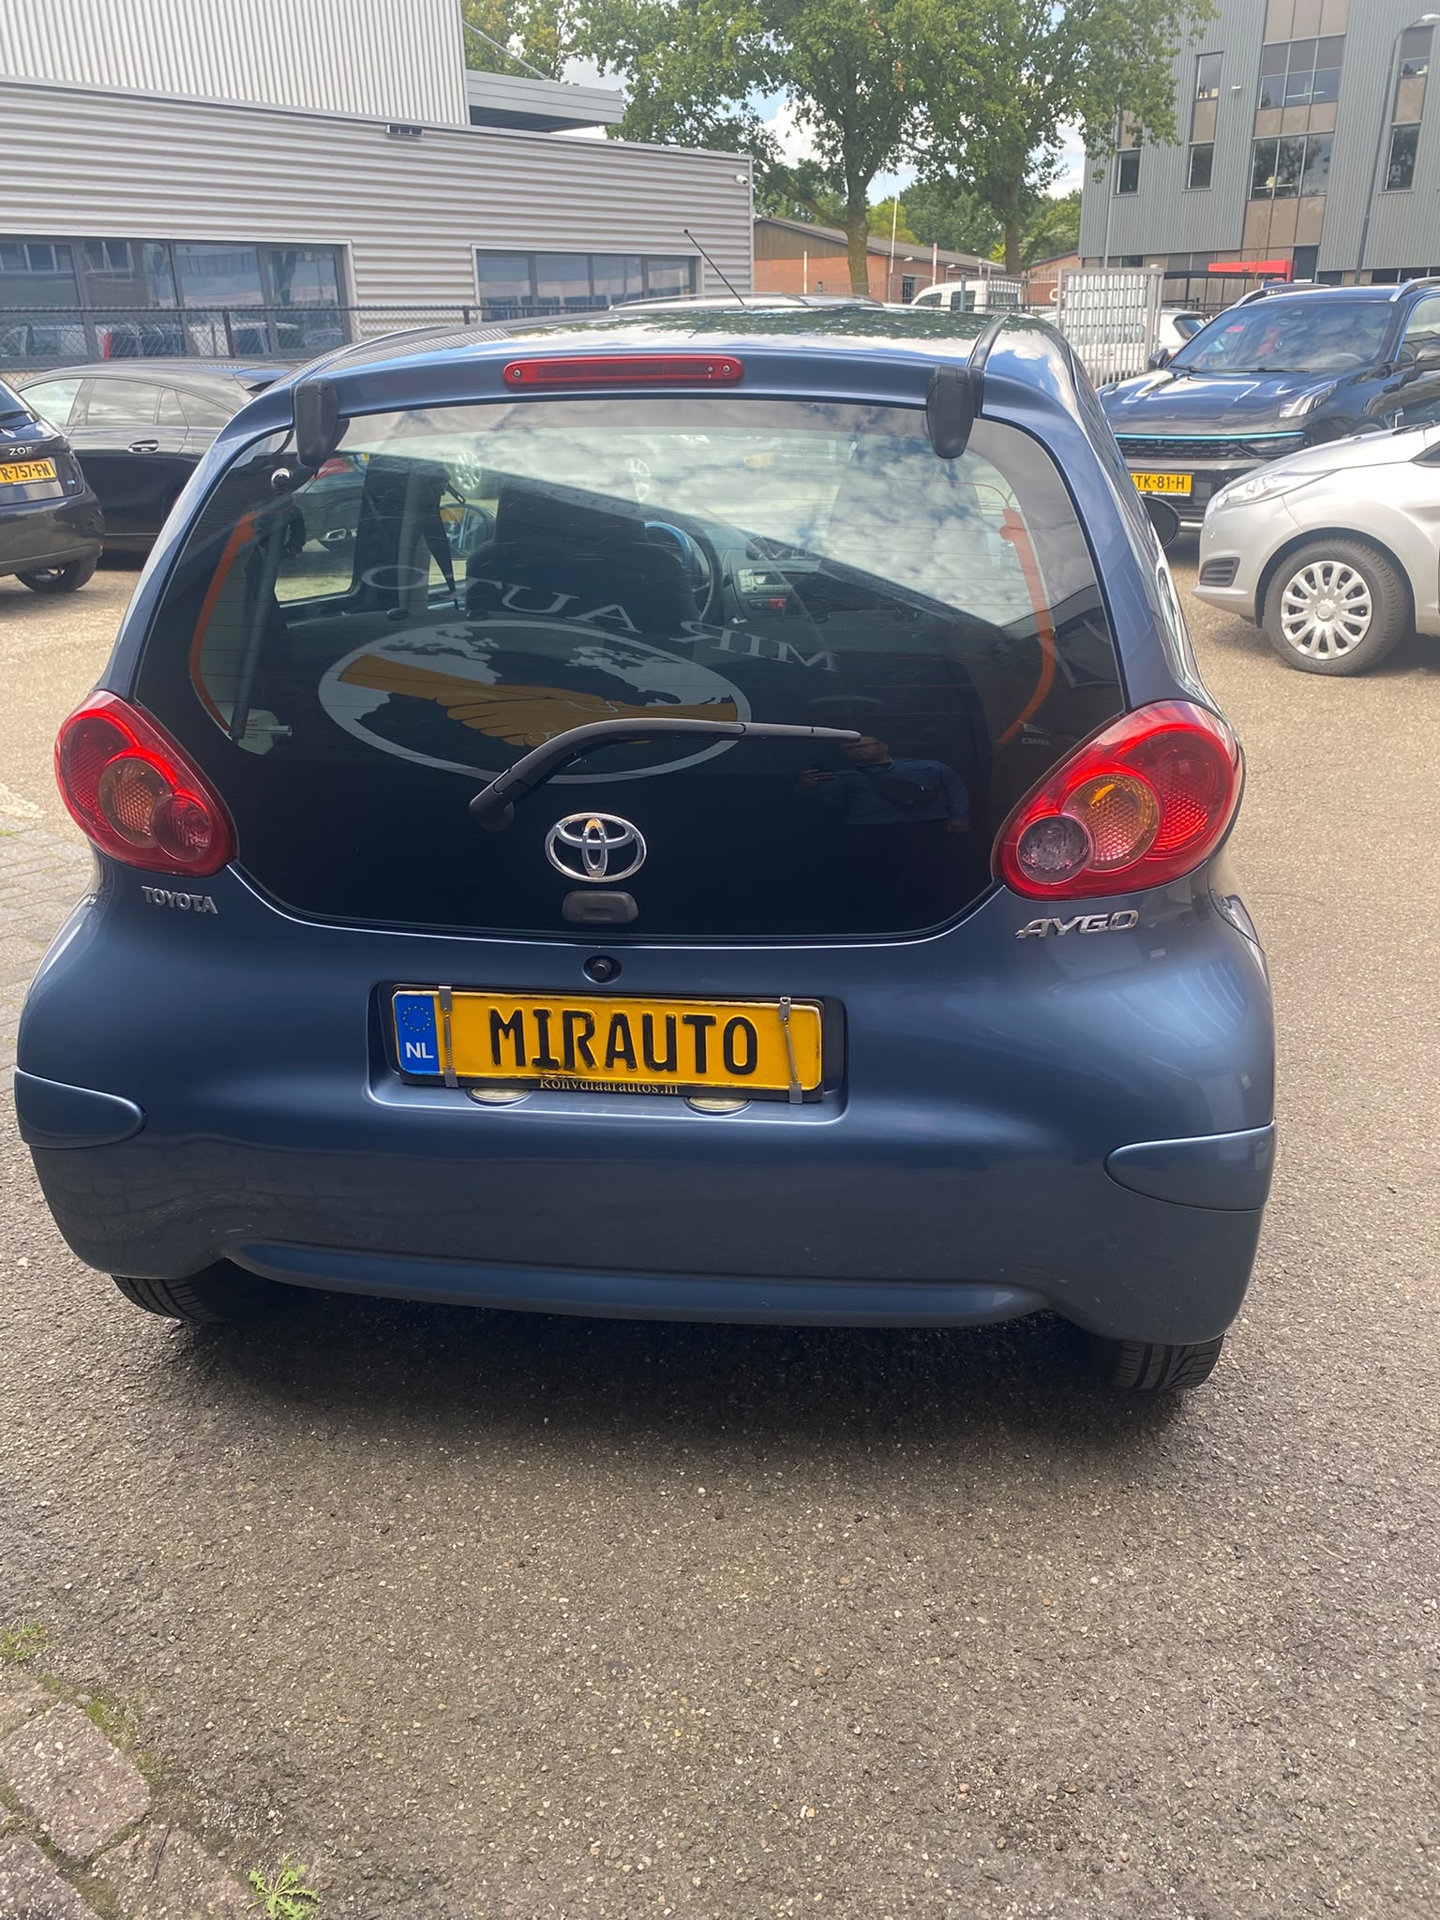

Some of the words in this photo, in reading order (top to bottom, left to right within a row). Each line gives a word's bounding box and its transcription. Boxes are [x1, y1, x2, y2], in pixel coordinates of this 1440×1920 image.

[1132, 475, 1185, 490] TK-81-H
[141, 885, 218, 914] TOYOTA
[1015, 909, 1139, 939] AYGO
[405, 1042, 434, 1060] NL
[488, 1007, 759, 1075] MIRAUTO
